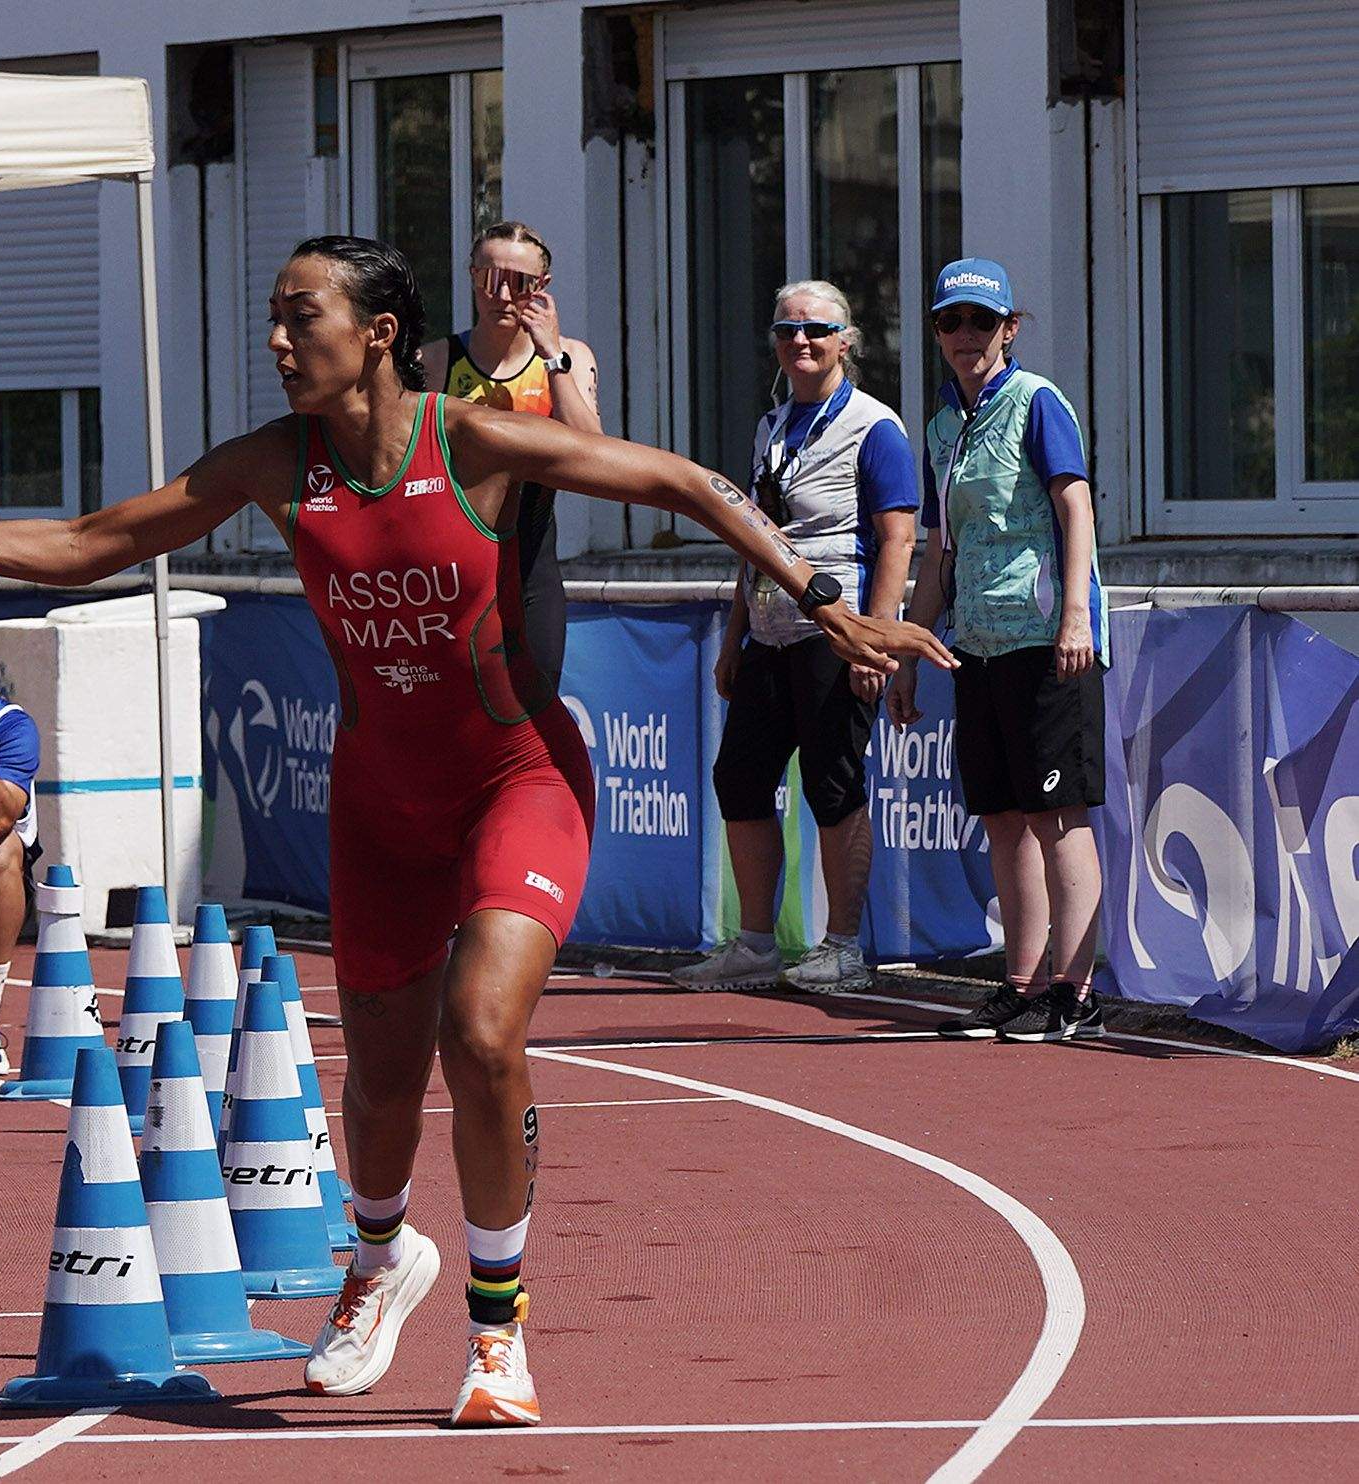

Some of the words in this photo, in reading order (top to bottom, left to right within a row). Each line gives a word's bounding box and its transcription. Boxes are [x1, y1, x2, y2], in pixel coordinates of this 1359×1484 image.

[944, 272, 1001, 291] Multisport
[305, 503, 338, 512] Triathlon
[310, 496, 333, 504] World
[328, 562, 460, 611] ASSOU
[341, 613, 456, 648] MAR
[412, 672, 442, 682] STORE
[281, 694, 337, 754] World
[603, 711, 667, 770] World
[879, 718, 956, 780] World
[605, 776, 689, 837] Triathlon
